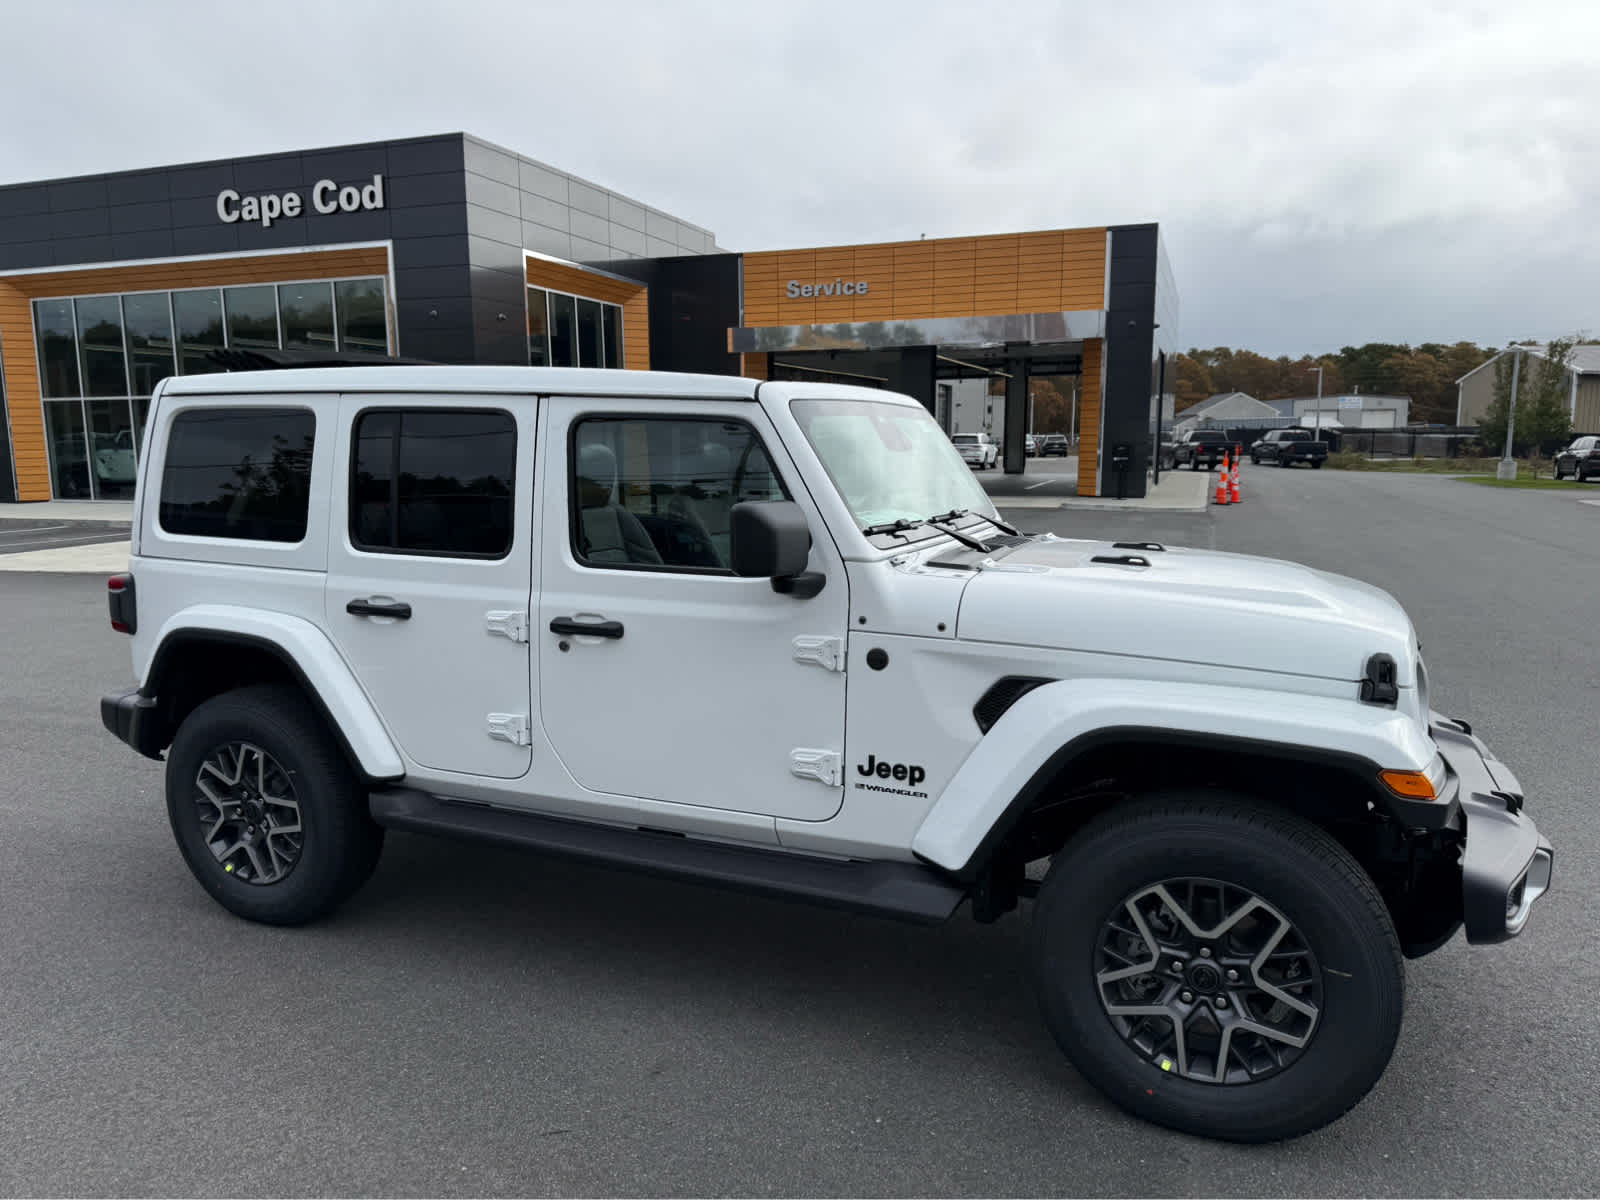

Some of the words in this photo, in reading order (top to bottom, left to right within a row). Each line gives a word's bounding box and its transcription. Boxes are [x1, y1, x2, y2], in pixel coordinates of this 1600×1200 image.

[216, 189, 302, 227] Cape
[312, 174, 385, 214] Cod
[786, 278, 869, 298] Service
[857, 754, 925, 787] Jeep
[865, 784, 928, 799] WRANGLER
